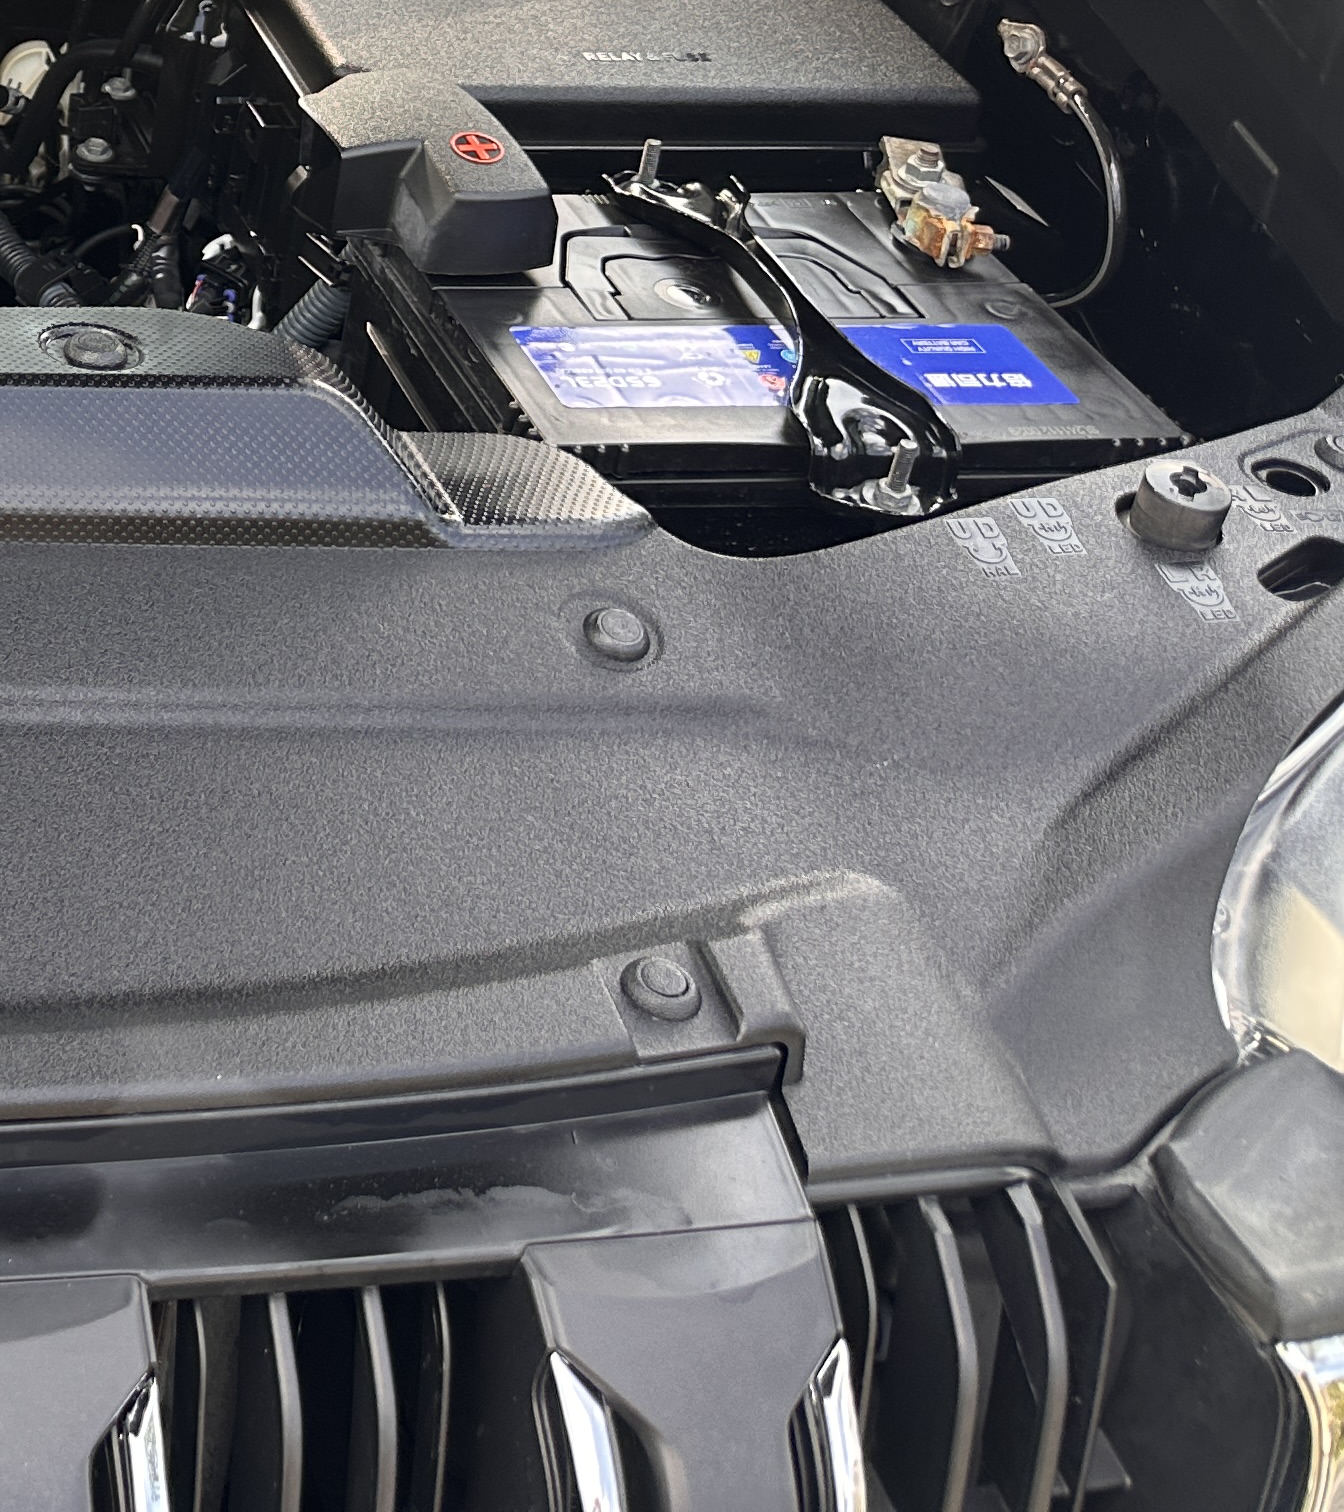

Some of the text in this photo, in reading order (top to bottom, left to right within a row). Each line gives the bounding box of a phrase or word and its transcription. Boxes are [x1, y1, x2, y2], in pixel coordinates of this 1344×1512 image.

[582, 51, 642, 63] RELAY
[1009, 500, 1064, 518] UD
[945, 519, 1000, 539] UD
[1047, 544, 1084, 554] LED
[1200, 609, 1237, 621] LED
